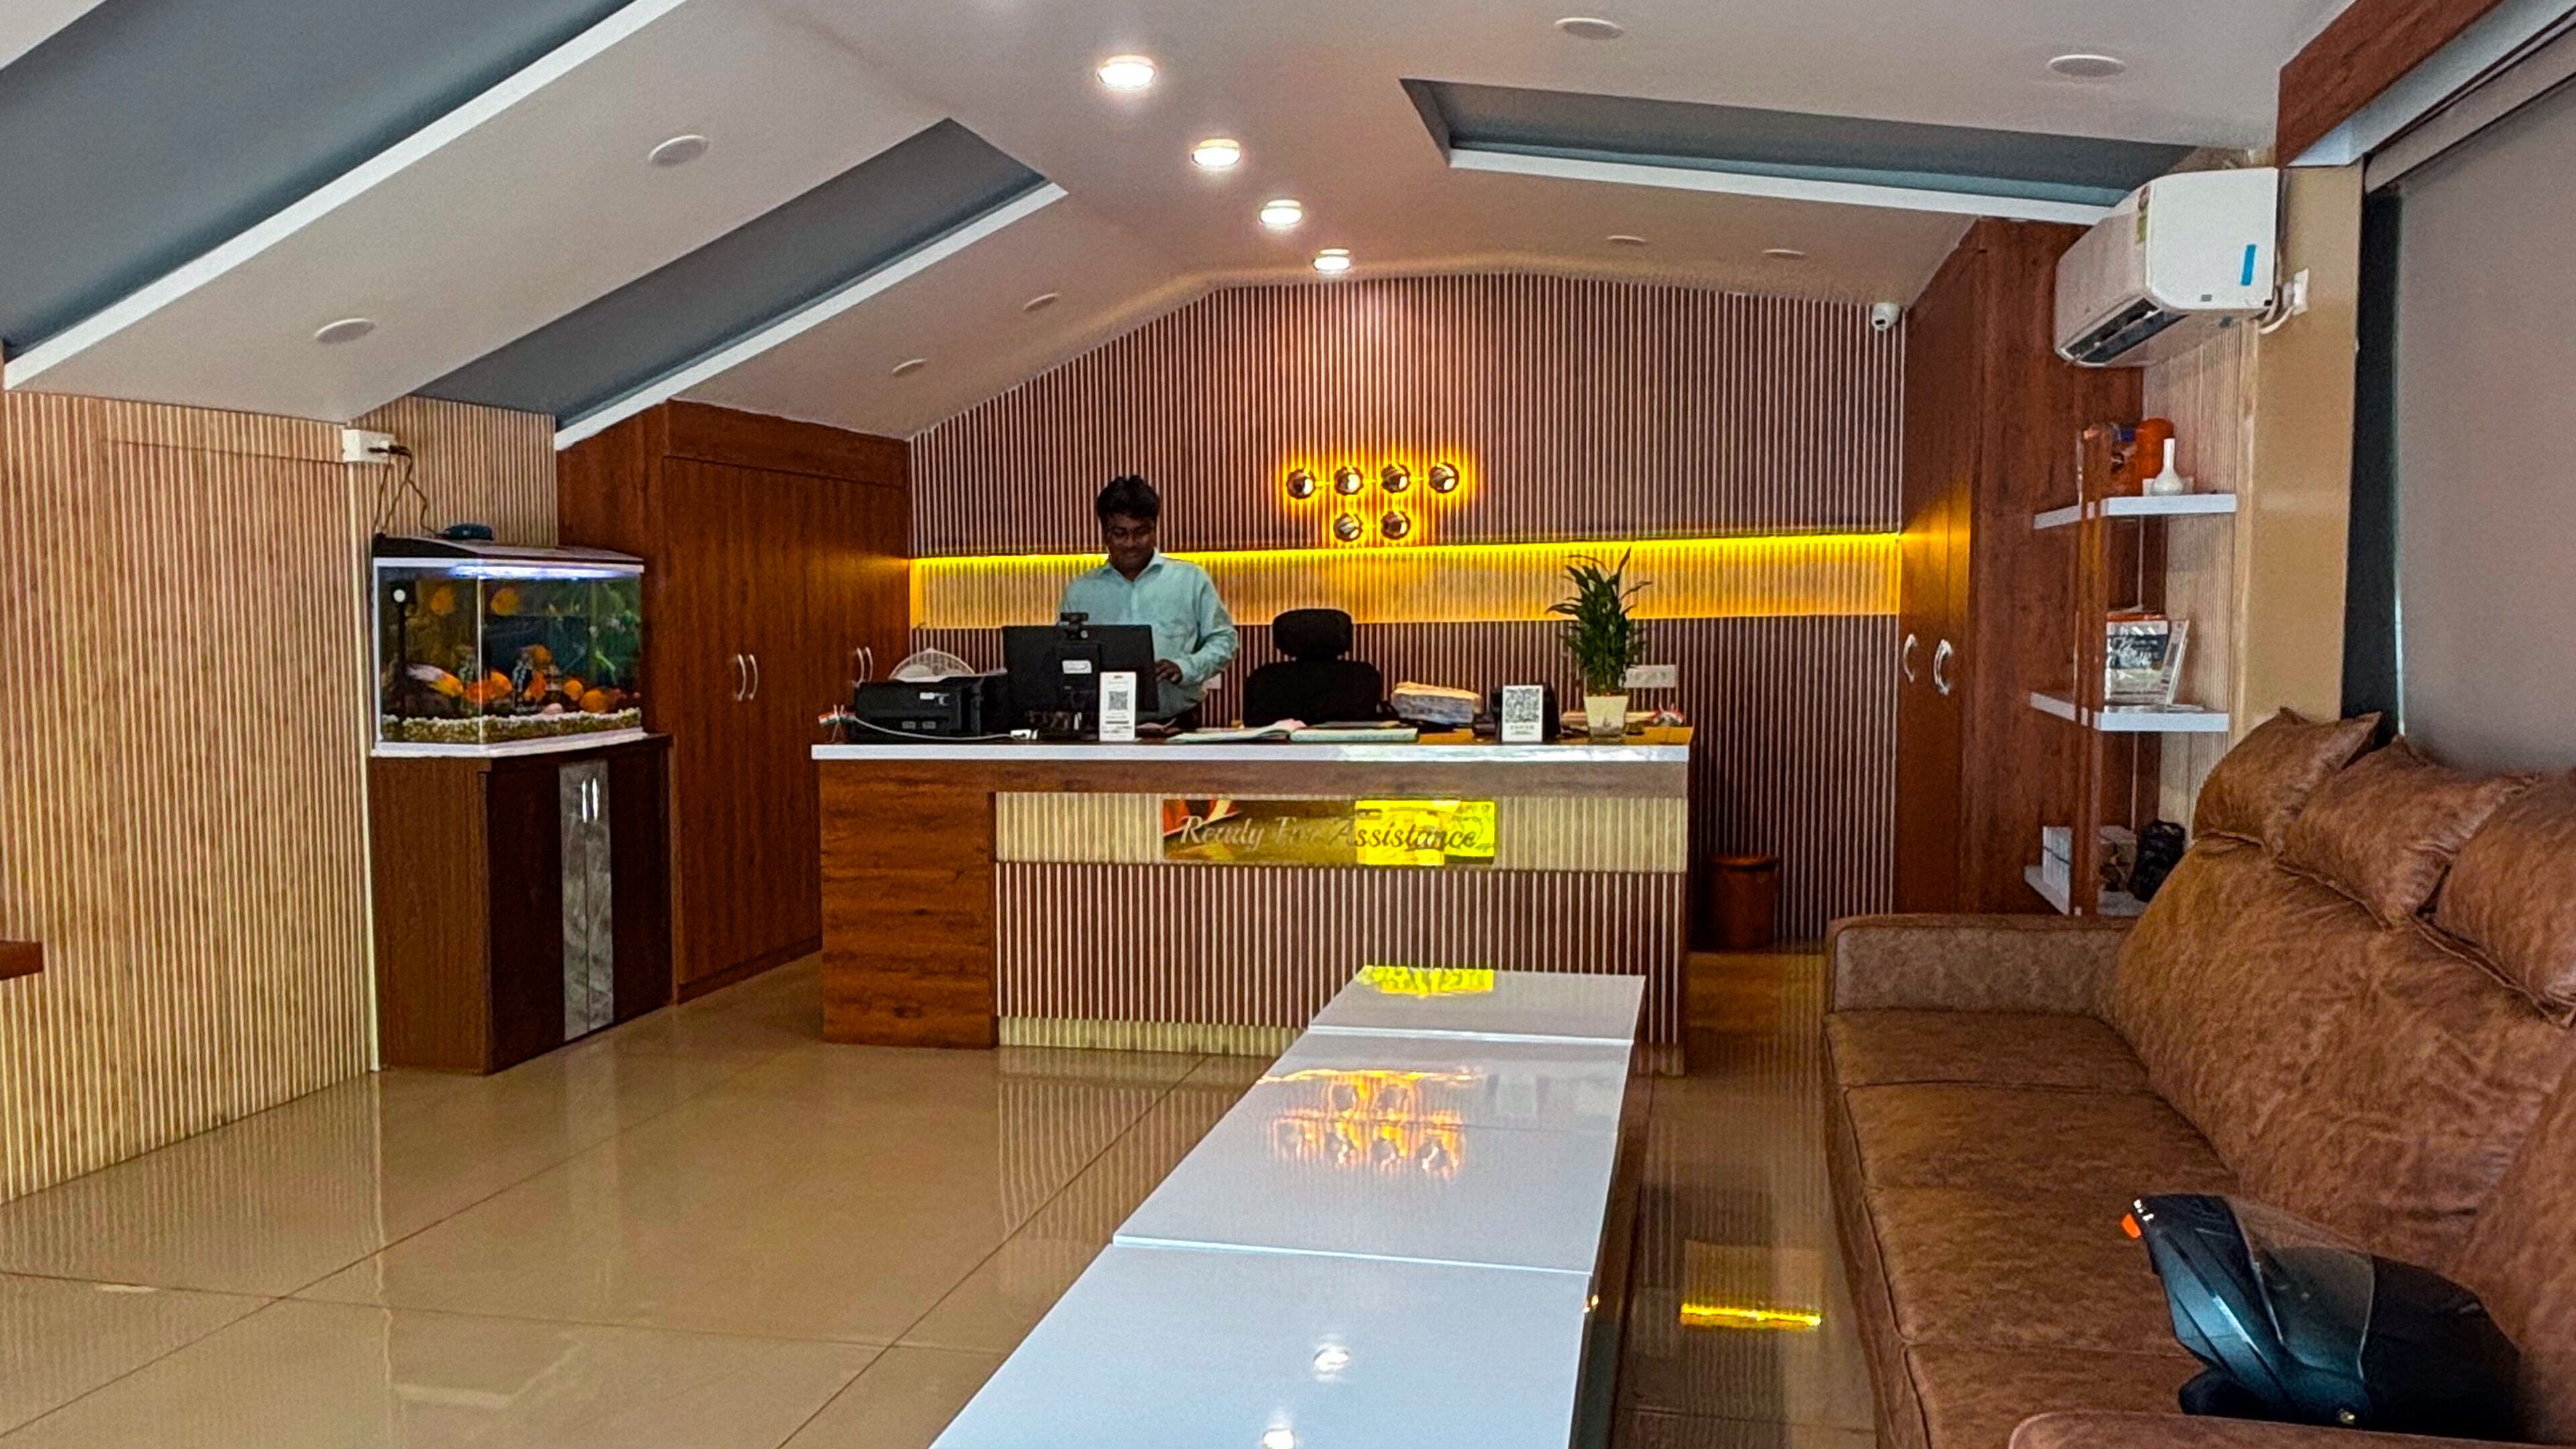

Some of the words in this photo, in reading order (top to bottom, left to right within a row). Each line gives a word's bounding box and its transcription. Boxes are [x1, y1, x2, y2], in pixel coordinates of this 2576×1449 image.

[1179, 815, 1265, 851] Ready
[1275, 816, 1320, 845] For
[1328, 817, 1476, 849] Assistance
